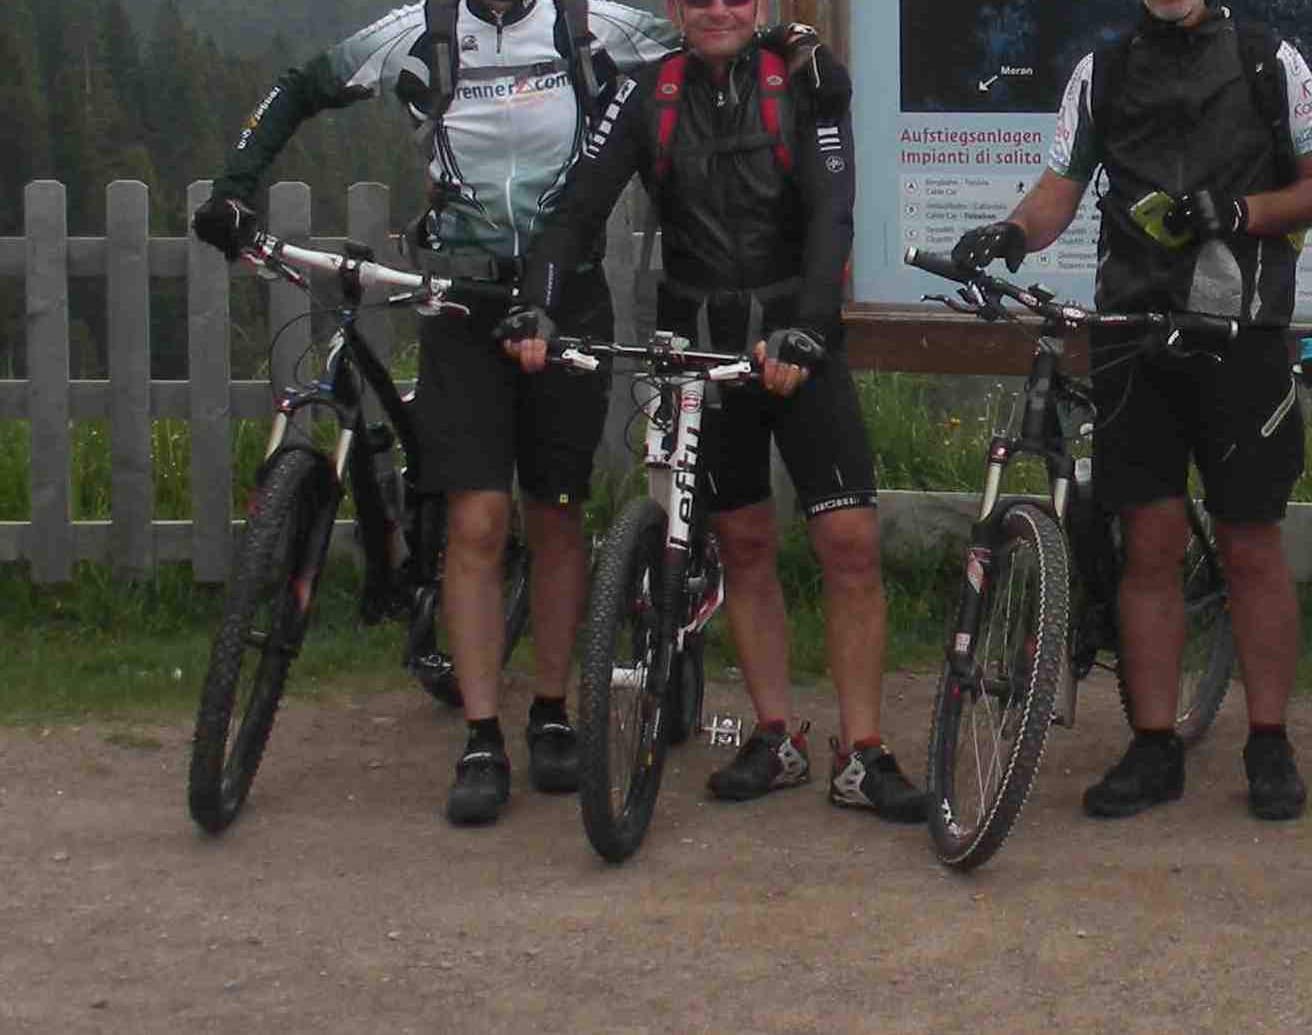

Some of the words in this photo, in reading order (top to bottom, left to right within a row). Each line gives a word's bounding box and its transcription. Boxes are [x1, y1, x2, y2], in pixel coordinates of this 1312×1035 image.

[900, 128, 1042, 146] Aufstiegsanlagen
[901, 148, 969, 165] Impianti
[975, 148, 990, 164] di
[996, 148, 1041, 164] salita
